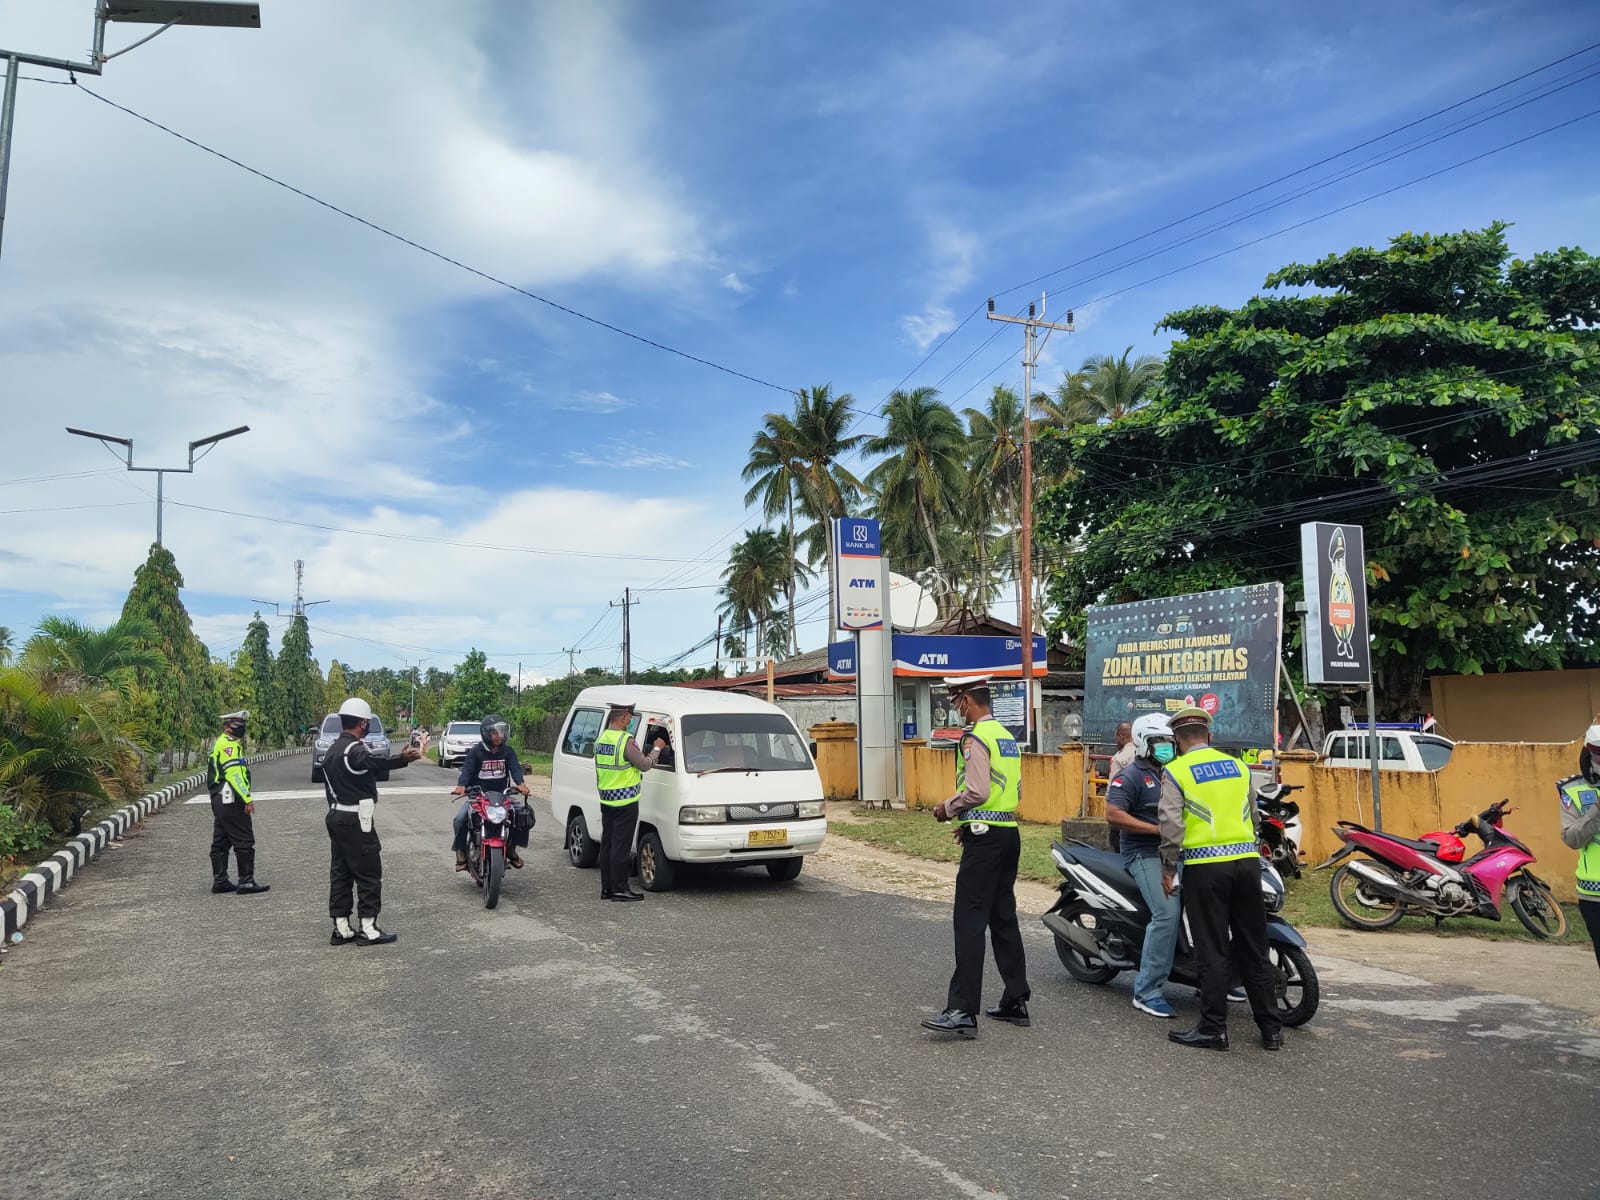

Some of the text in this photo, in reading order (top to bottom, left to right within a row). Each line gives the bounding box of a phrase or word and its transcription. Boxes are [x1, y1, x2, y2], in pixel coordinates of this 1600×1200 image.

[849, 579, 875, 588] ATM
[1117, 634, 1232, 654] ANDA MEMASUKI KAWASAN
[837, 659, 852, 670] ATM
[918, 653, 949, 665] ATM
[1102, 647, 1249, 677] ZONA INTEGRITAS
[1213, 671, 1248, 681] MELAYANI
[1193, 762, 1240, 780] POLISI
